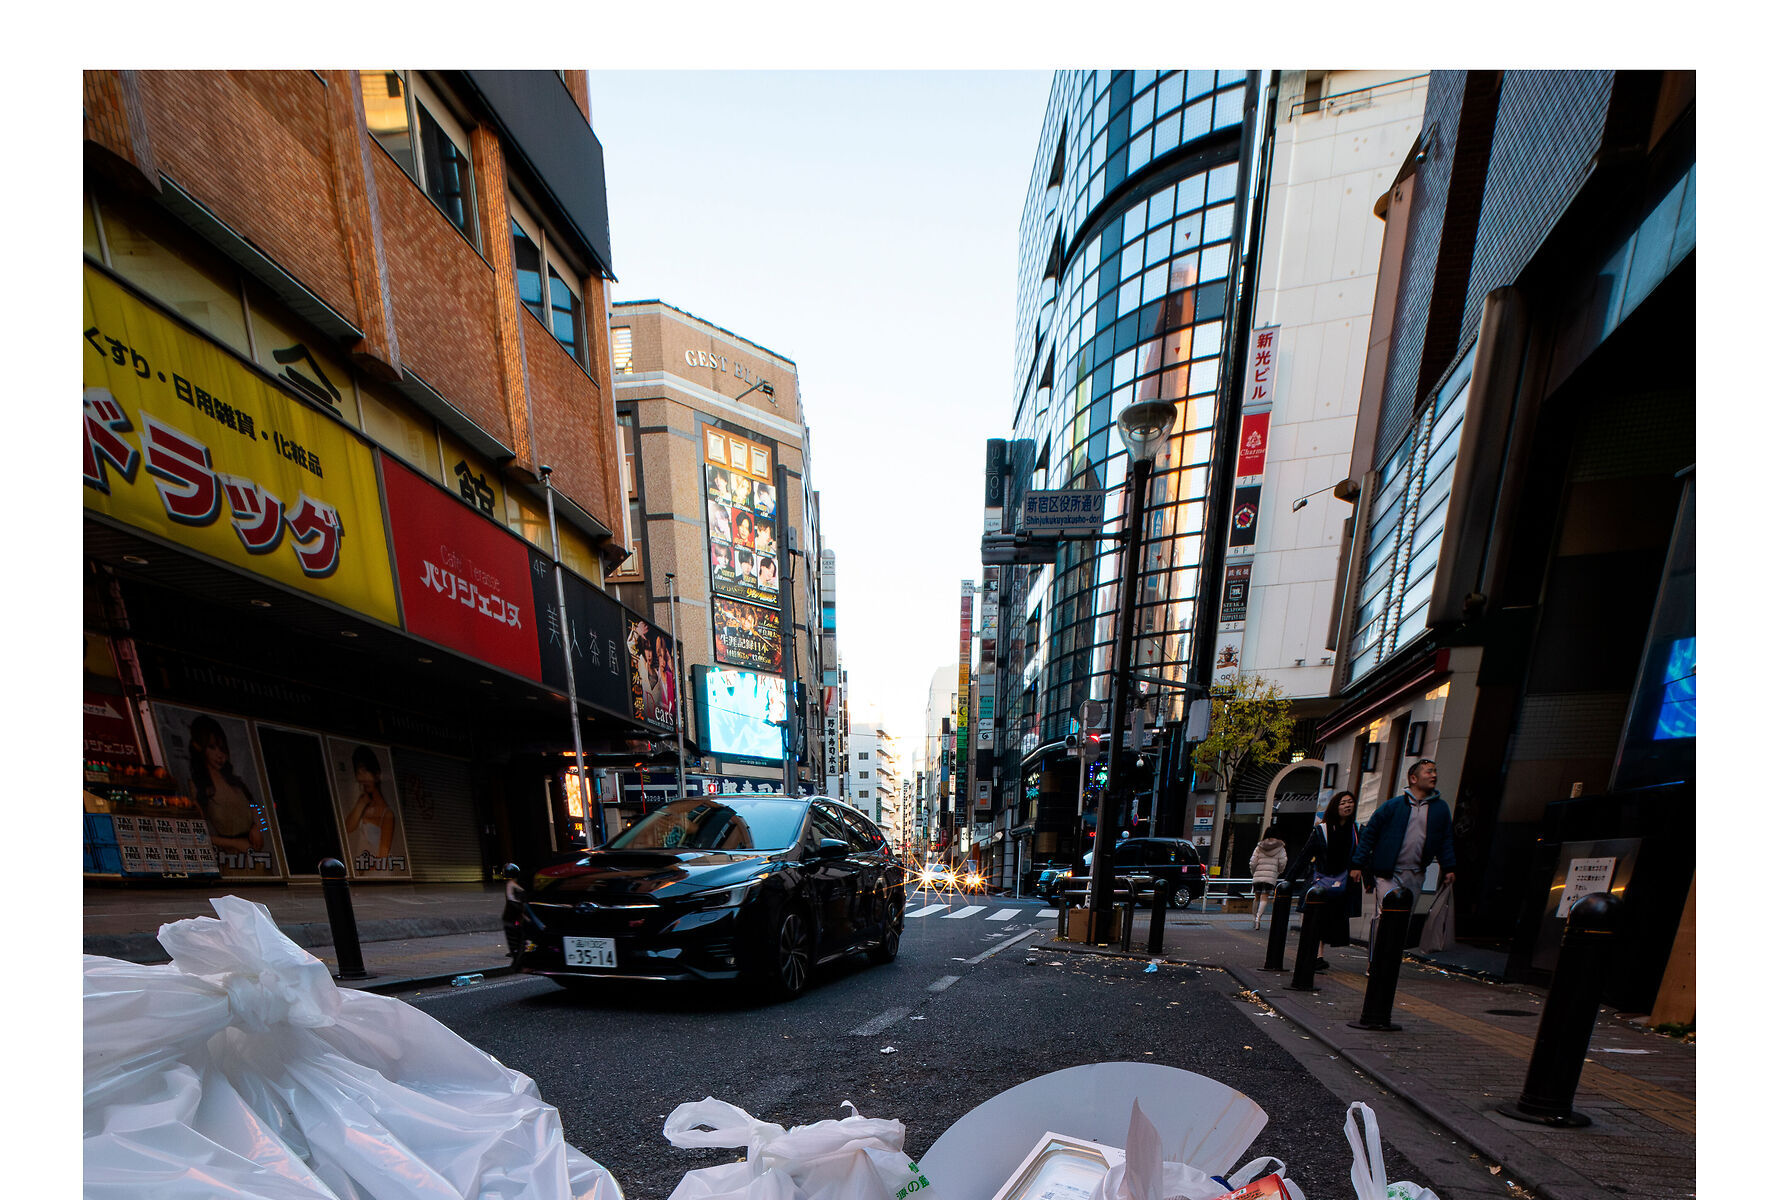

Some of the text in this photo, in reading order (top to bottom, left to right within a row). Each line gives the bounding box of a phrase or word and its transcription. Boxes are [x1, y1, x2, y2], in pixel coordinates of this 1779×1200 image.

[684, 349, 728, 374] GEST
[1251, 331, 1274, 401] 新光ビル
[1027, 494, 1103, 514] 新宿区役所通り
[1026, 514, 1103, 527] Shinjukukuyakusho-dori
[533, 558, 547, 580] 4F
[545, 603, 621, 676] 美人茶屋
[576, 949, 613, 966] 35-14
